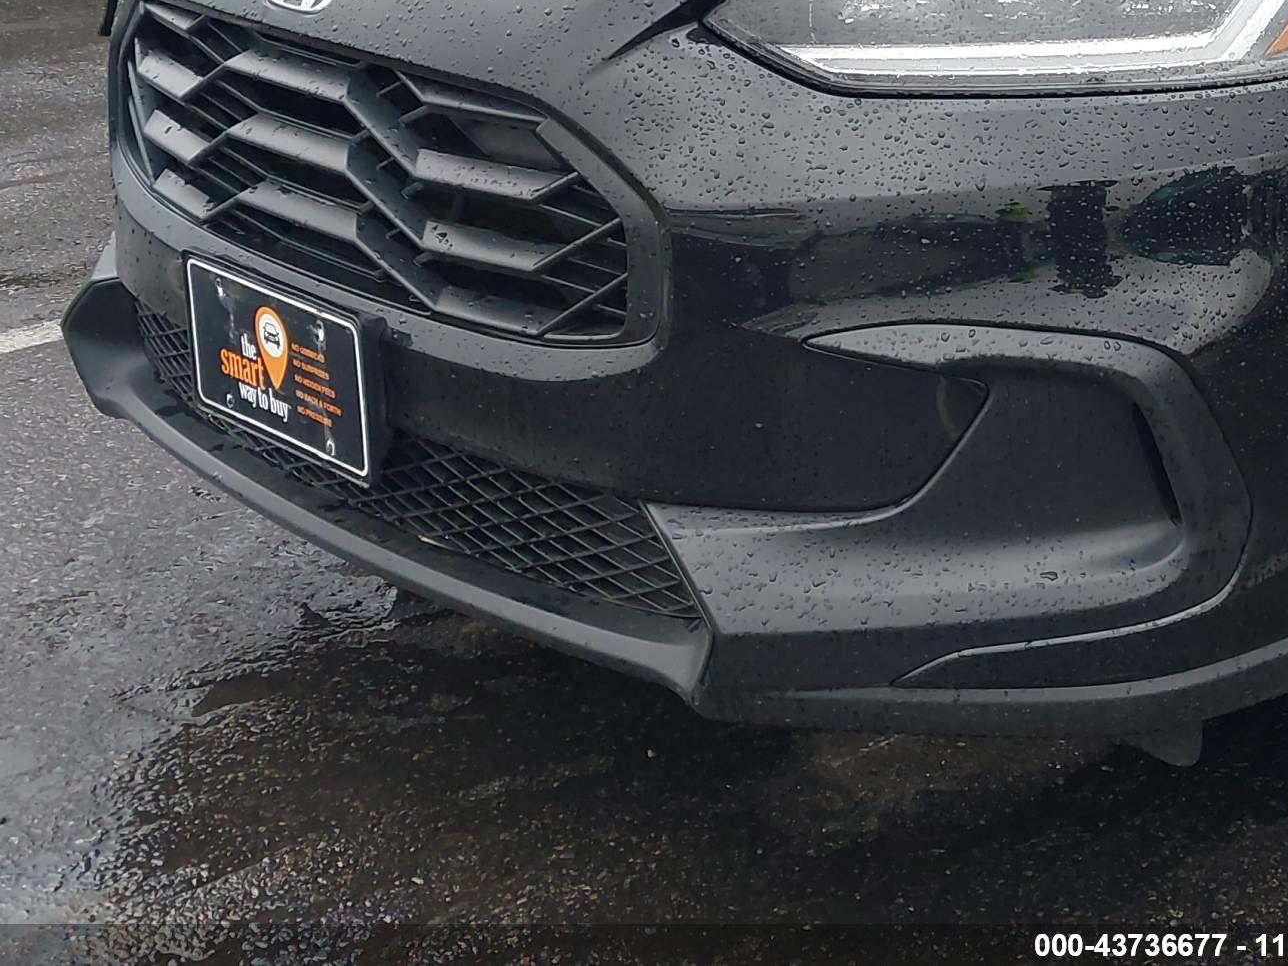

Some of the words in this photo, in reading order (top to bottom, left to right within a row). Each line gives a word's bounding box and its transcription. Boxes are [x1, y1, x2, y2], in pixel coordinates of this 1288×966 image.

[241, 332, 257, 360] the
[220, 347, 266, 390] smart
[238, 381, 257, 409] way
[257, 386, 268, 411] to
[268, 387, 289, 422] buy
